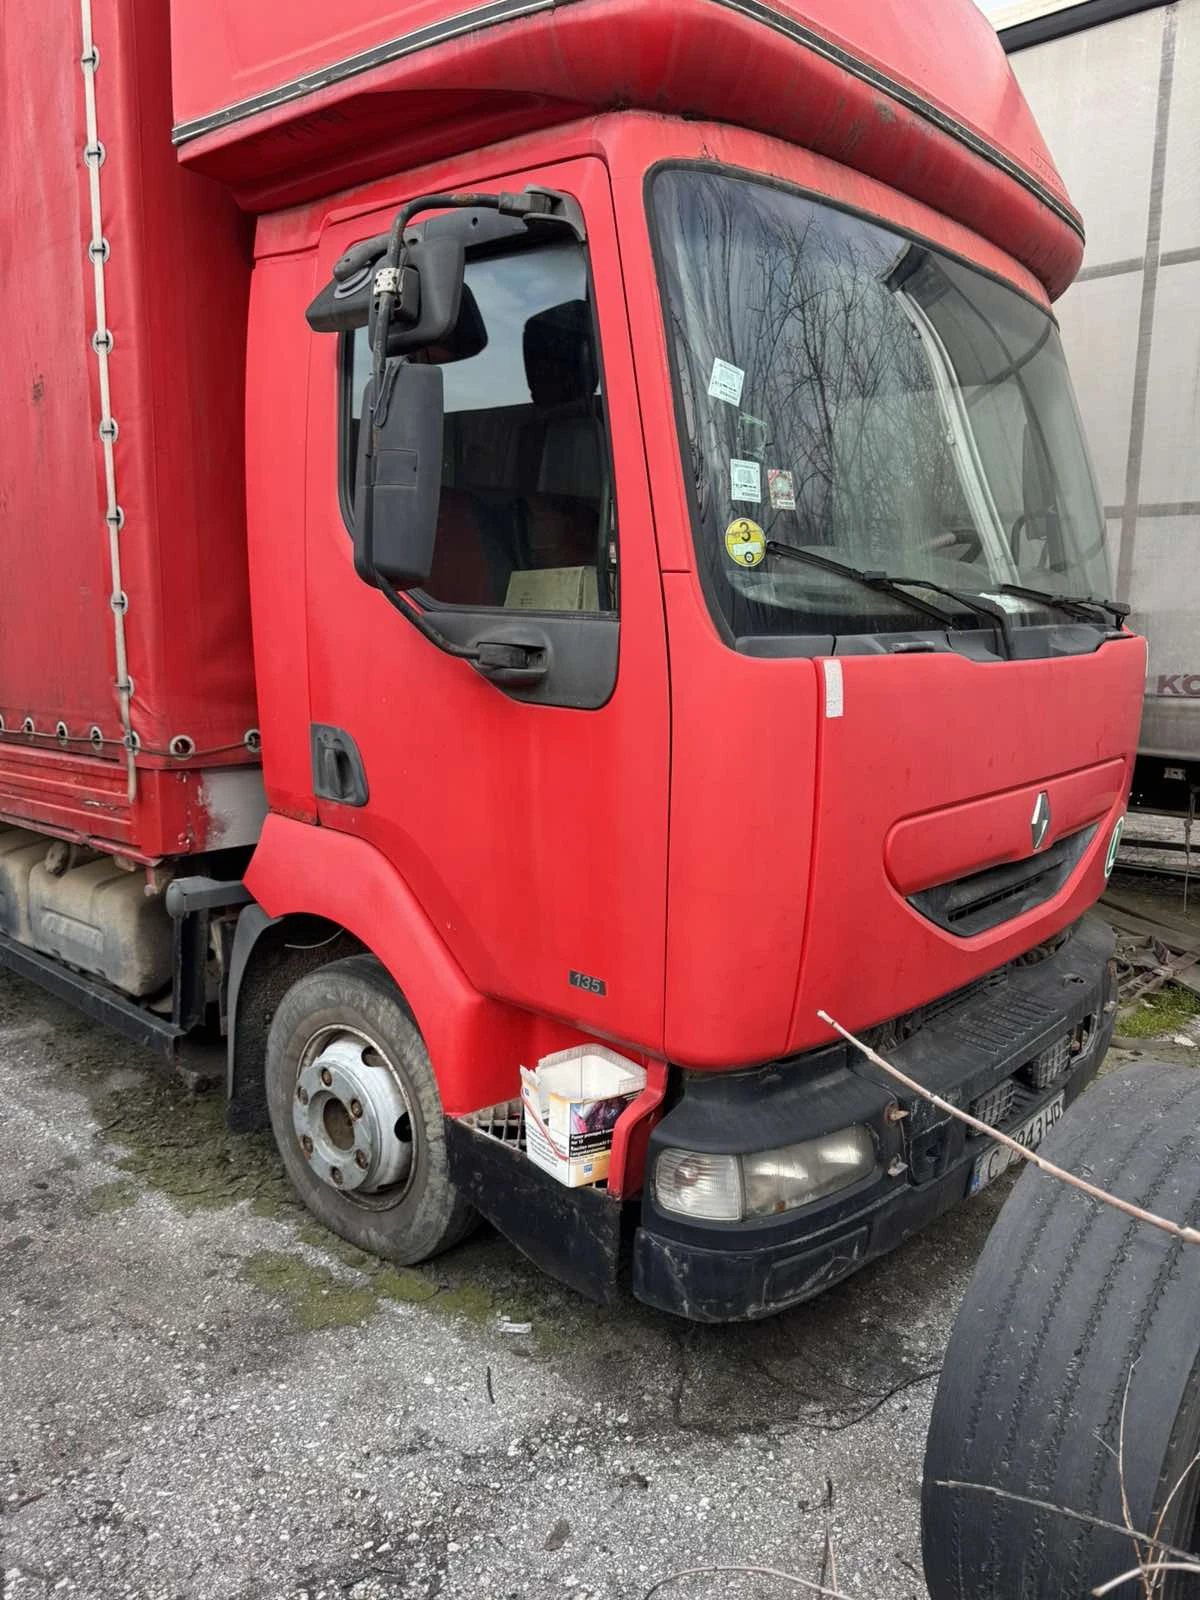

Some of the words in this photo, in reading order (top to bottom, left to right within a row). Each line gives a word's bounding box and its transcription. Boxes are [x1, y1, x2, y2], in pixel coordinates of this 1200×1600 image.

[739, 521, 752, 542] 3
[574, 974, 600, 993] 135
[988, 1149, 1000, 1180] C
